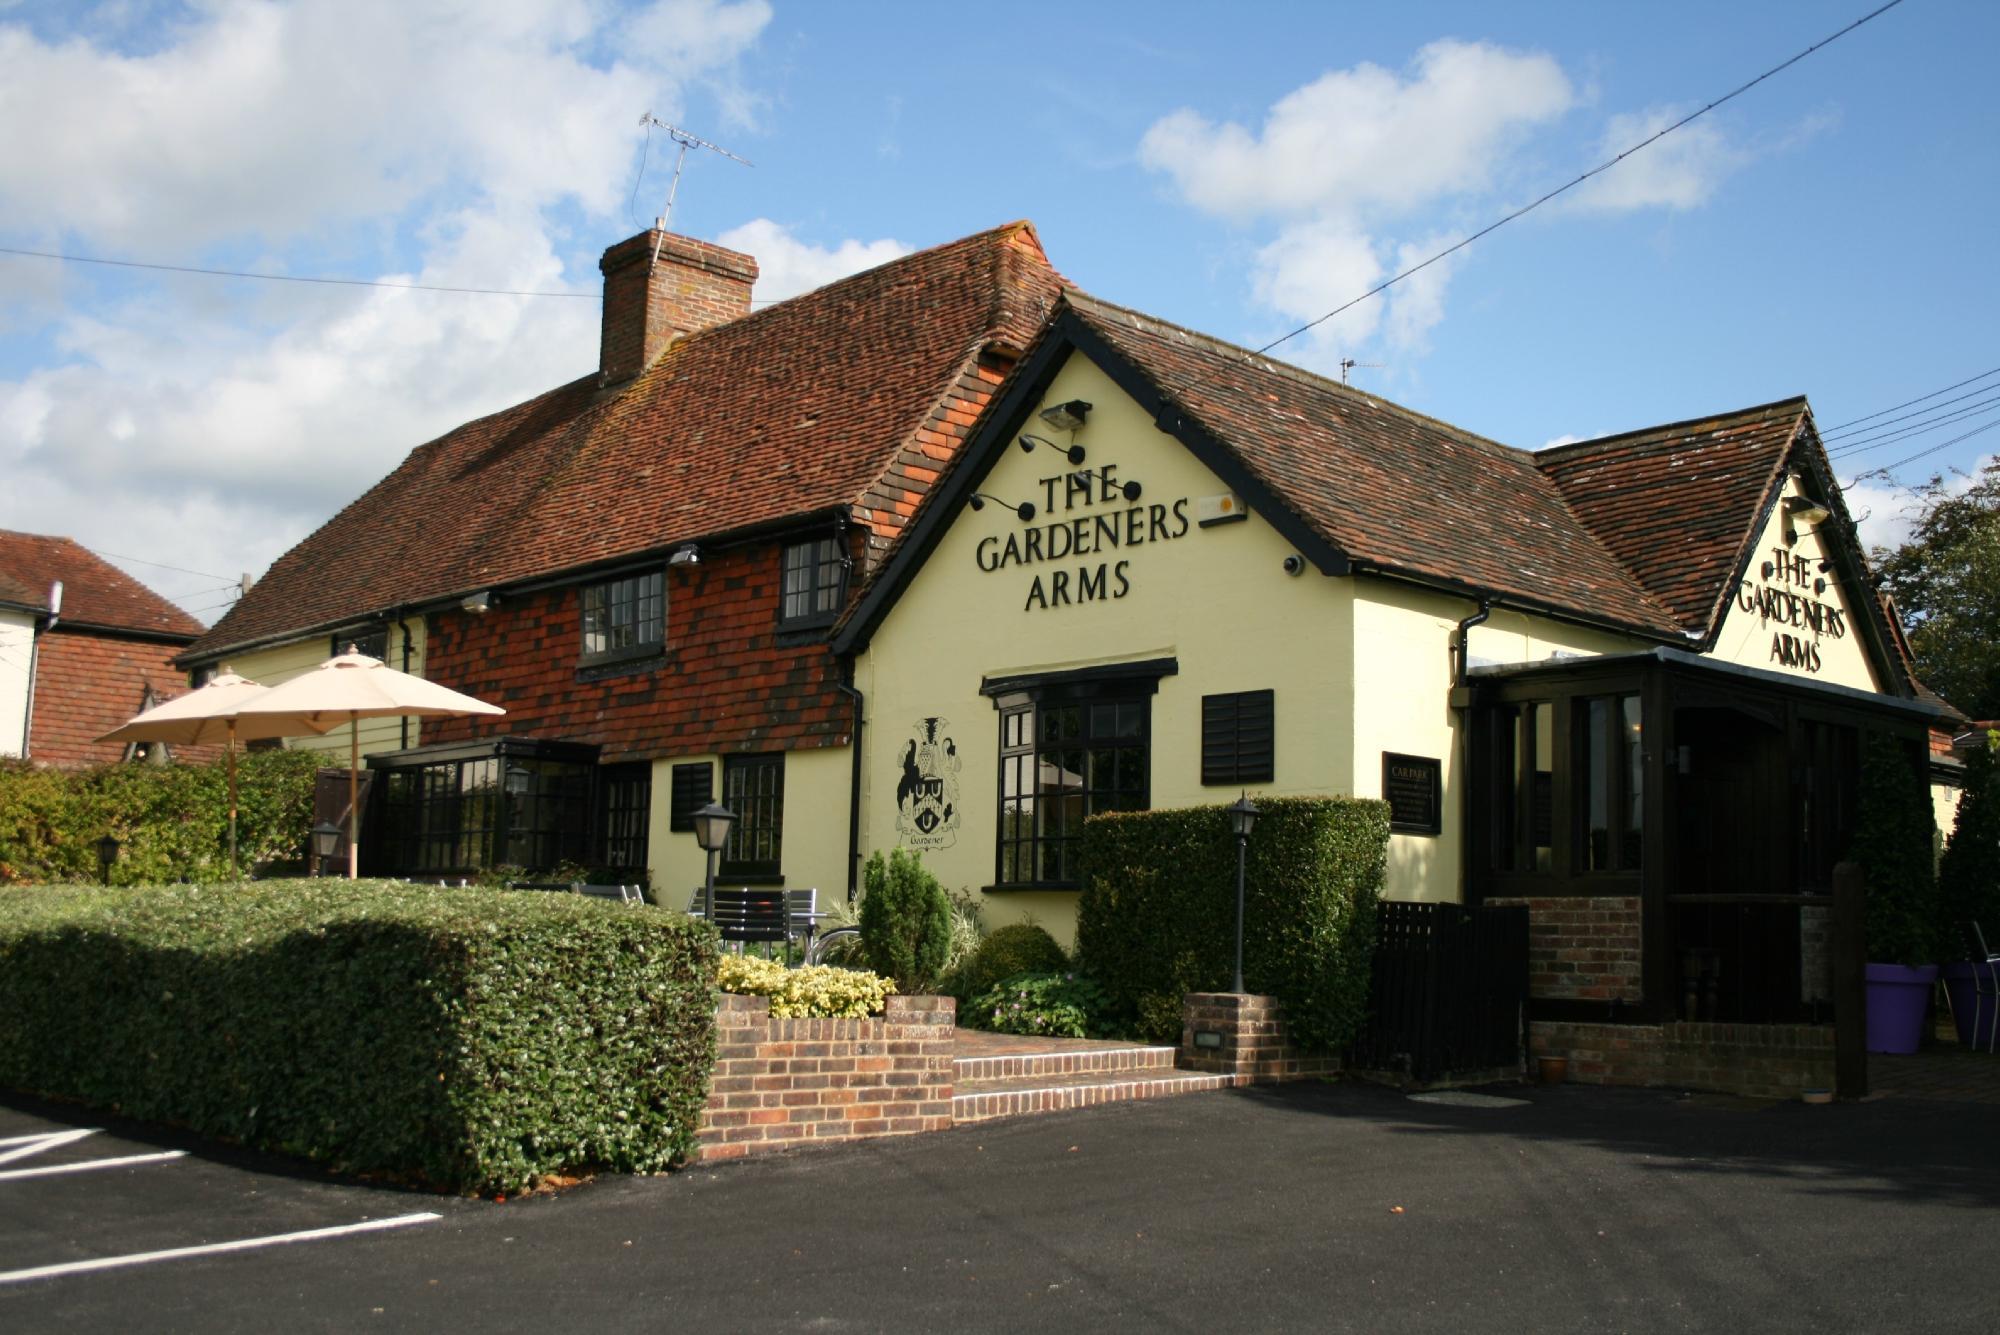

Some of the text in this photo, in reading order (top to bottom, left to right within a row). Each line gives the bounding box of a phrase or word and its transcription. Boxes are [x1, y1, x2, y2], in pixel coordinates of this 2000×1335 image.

[1039, 464, 1117, 514] THE
[976, 497, 1189, 573] GARDENERS
[1024, 560, 1130, 611] ARMS
[1772, 548, 1810, 589] THE
[1737, 580, 1844, 639] GARDENERS
[1770, 632, 1821, 673] ARMS
[911, 834, 943, 844] Gardener
